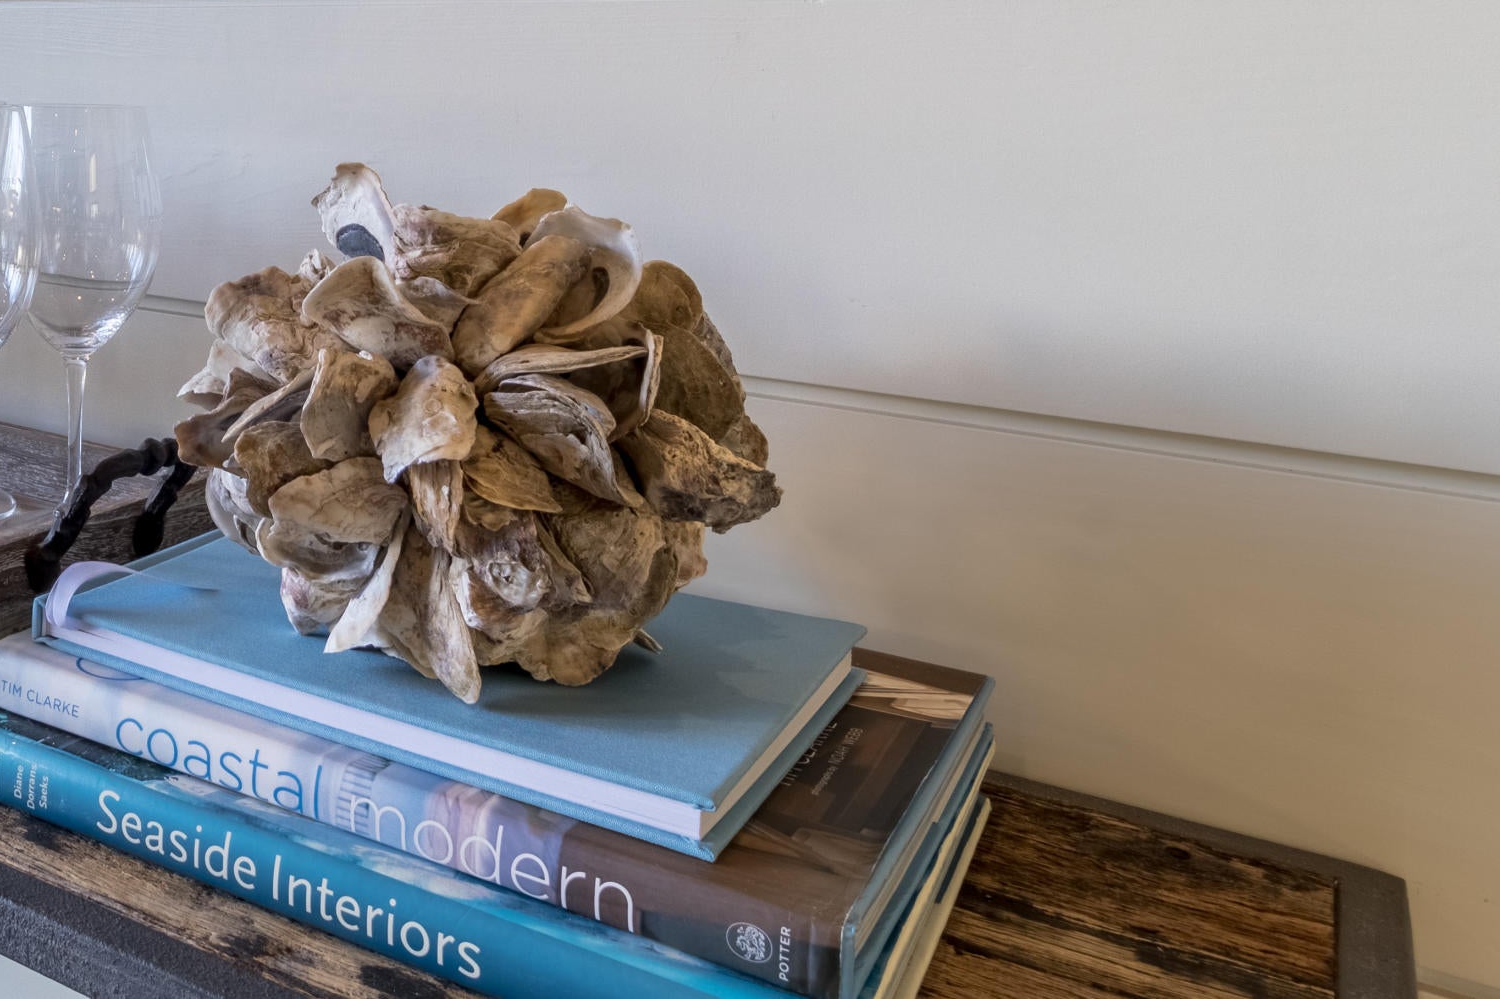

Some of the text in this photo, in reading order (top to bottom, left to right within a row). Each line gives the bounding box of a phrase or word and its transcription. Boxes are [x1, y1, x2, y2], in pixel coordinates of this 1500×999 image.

[2, 680, 80, 719] TIM CLARKE
[14, 764, 24, 799] Diane
[27, 762, 38, 810] Dorrans
[39, 776, 49, 809] Saeks
[115, 717, 635, 933] coastal modern
[96, 789, 482, 980] Seaside Interiors
[779, 926, 791, 982] POTTER
